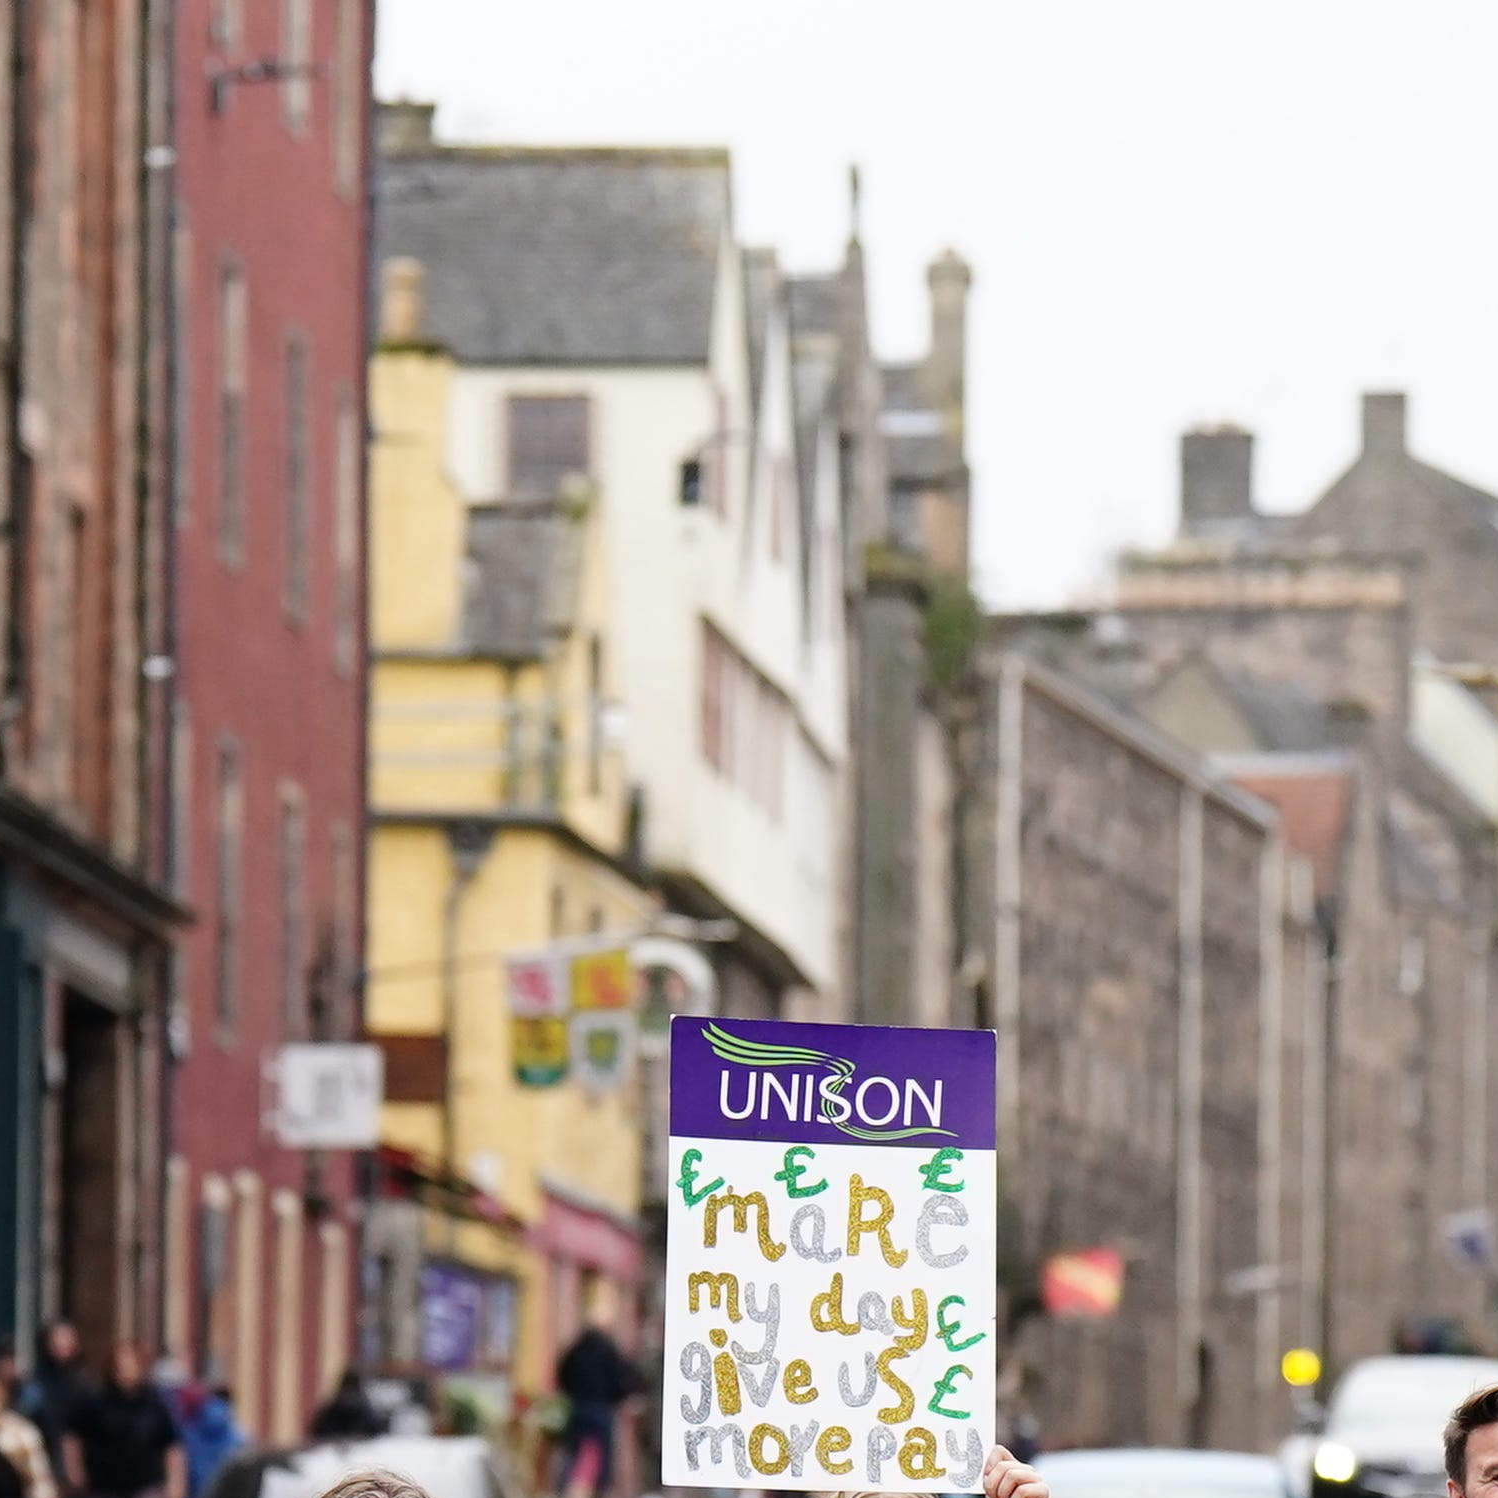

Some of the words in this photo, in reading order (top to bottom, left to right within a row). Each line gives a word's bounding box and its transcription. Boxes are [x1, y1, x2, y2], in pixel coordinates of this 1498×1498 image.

[721, 1070, 943, 1128] UNISON
[686, 1270, 783, 1365] my
[809, 1272, 928, 1351] day
[679, 1328, 818, 1424] give
[836, 1347, 916, 1424] us
[683, 1420, 855, 1480] more
[866, 1426, 984, 1487] pay
